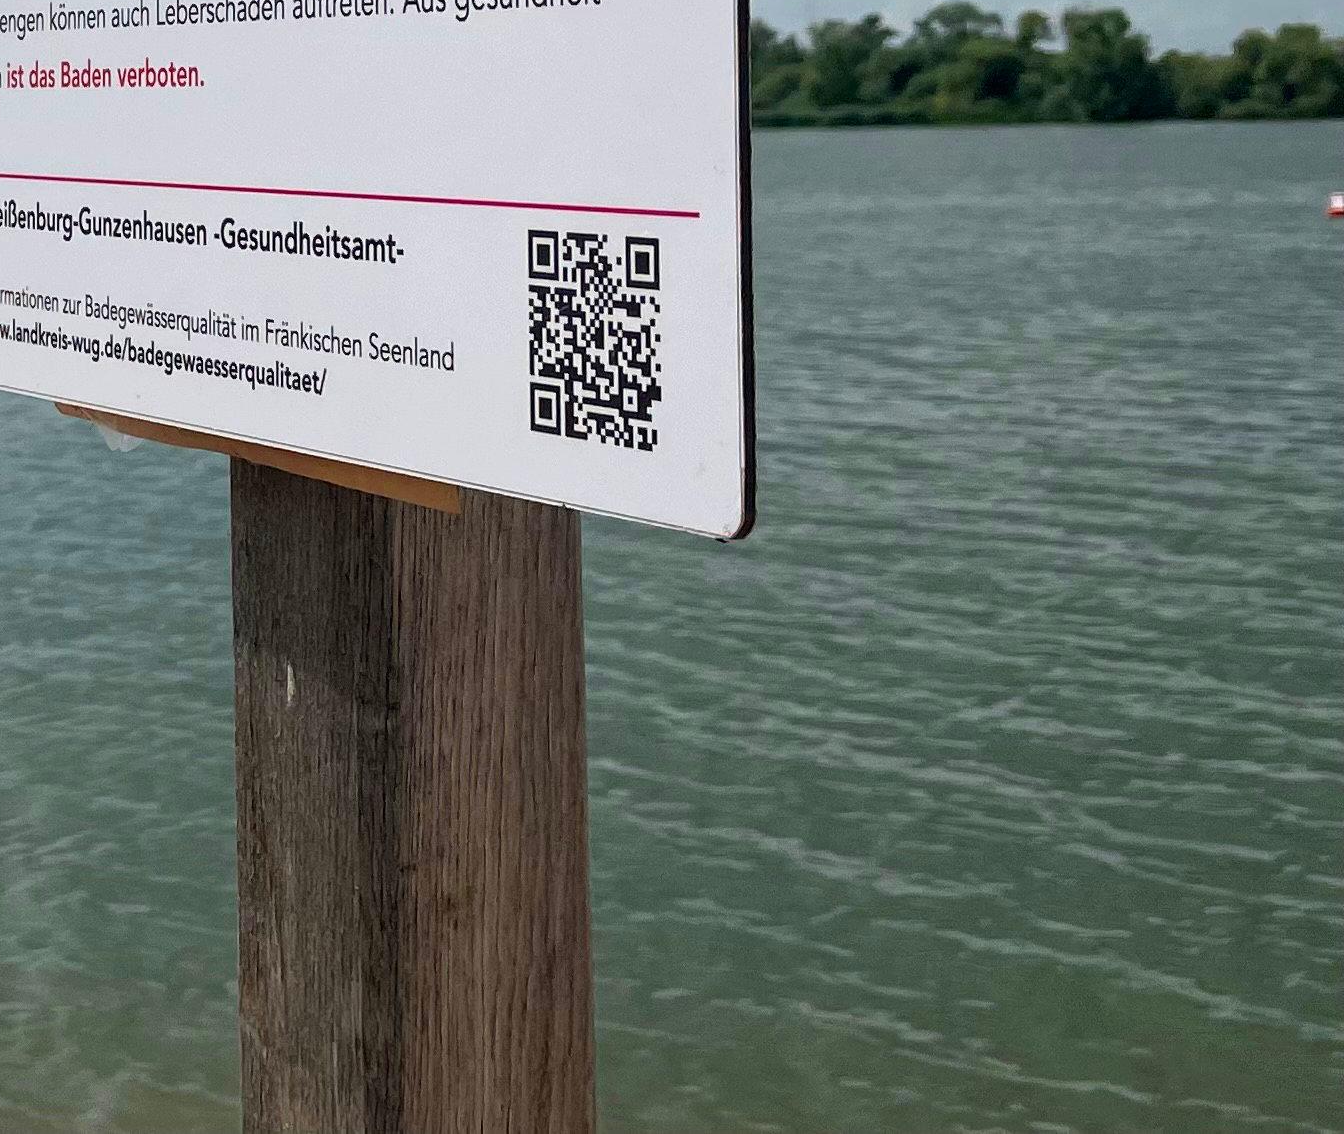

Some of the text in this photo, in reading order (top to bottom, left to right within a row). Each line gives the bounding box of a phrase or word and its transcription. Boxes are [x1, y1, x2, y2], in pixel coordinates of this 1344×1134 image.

[49, 2, 105, 31] können
[6, 62, 24, 89] ist
[29, 60, 55, 88] das
[61, 58, 111, 88] Baden
[117, 57, 204, 88] verboten.
[213, 217, 404, 264] -Gesundheitsamt-
[62, 298, 82, 315] zur
[85, 294, 237, 341] Badegewässerqualität
[241, 316, 259, 342] im
[265, 318, 362, 357] Fränkischen
[369, 332, 454, 371] Seenland
